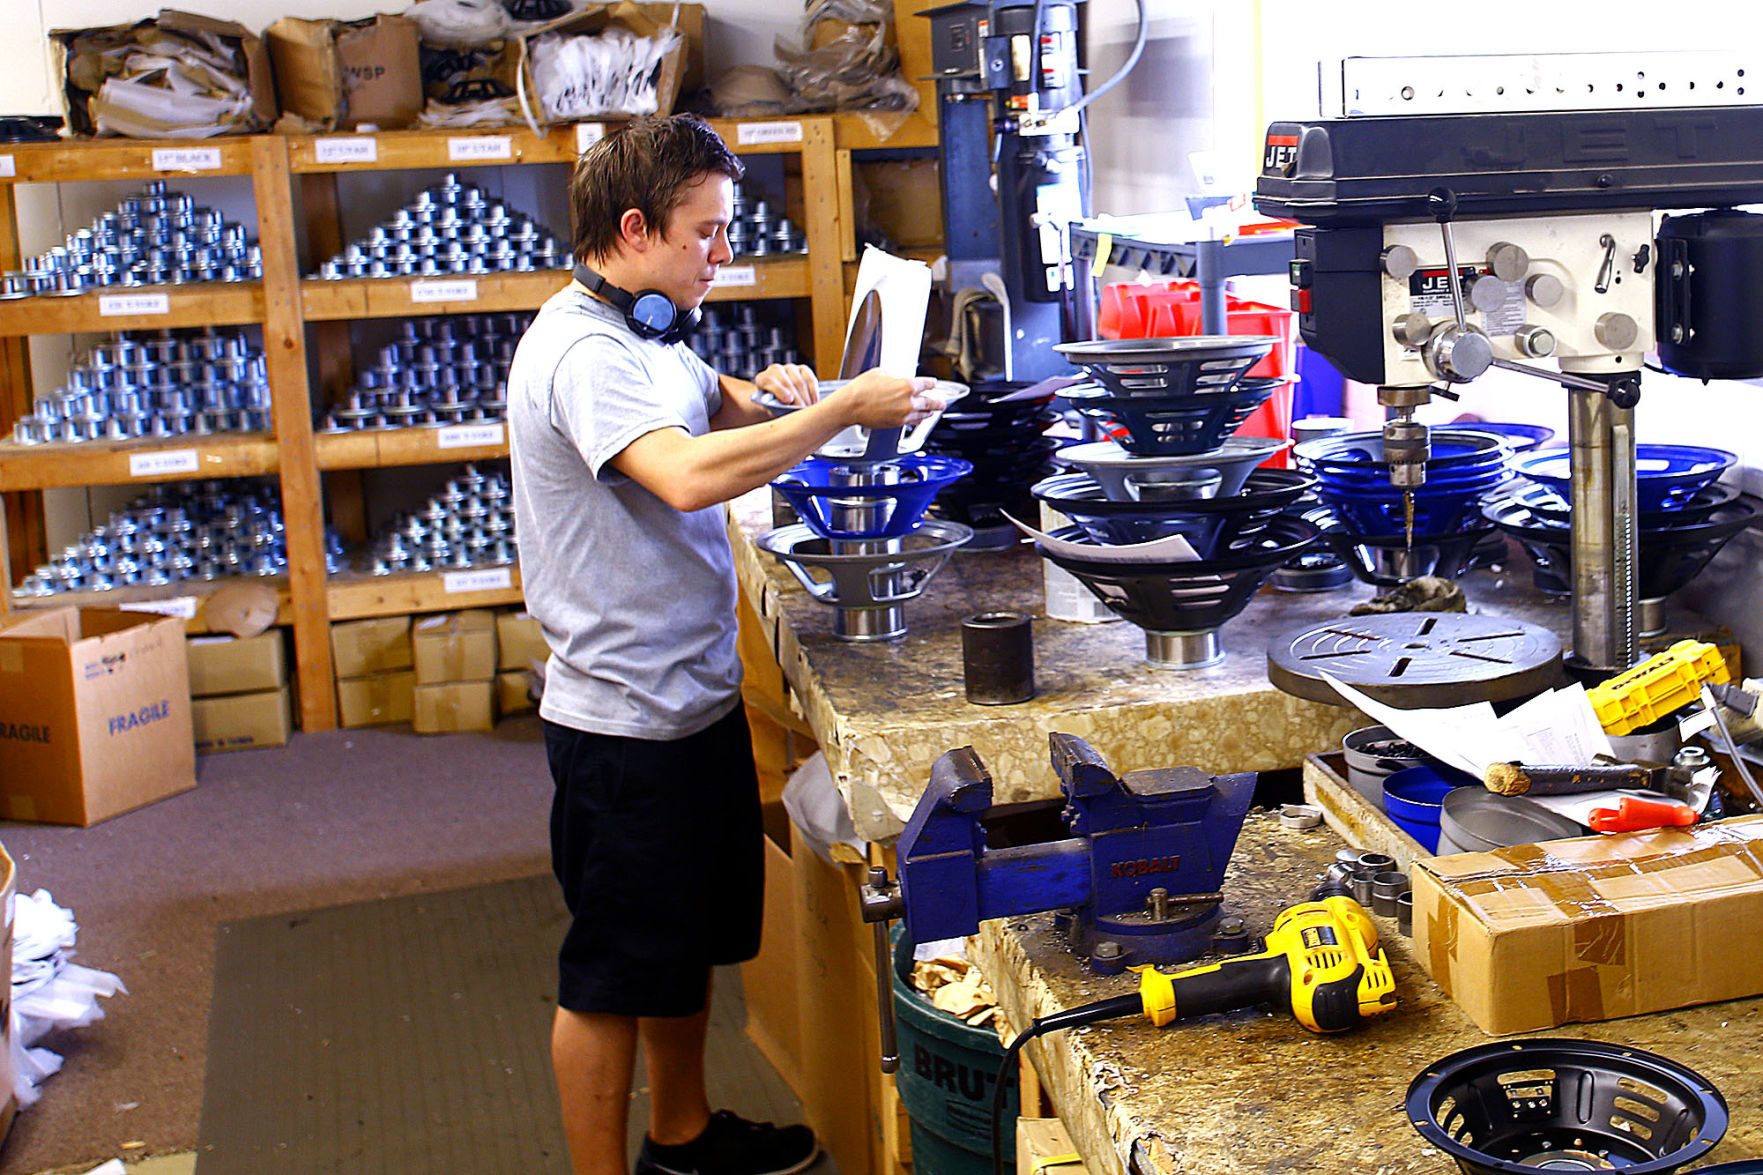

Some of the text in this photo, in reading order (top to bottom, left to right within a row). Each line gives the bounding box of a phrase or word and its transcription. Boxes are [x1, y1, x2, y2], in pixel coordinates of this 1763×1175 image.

[1264, 145, 1298, 168] JET
[1459, 115, 1718, 170] JET
[108, 699, 171, 737] FRAGILE
[1111, 854, 1182, 879] KOBALT
